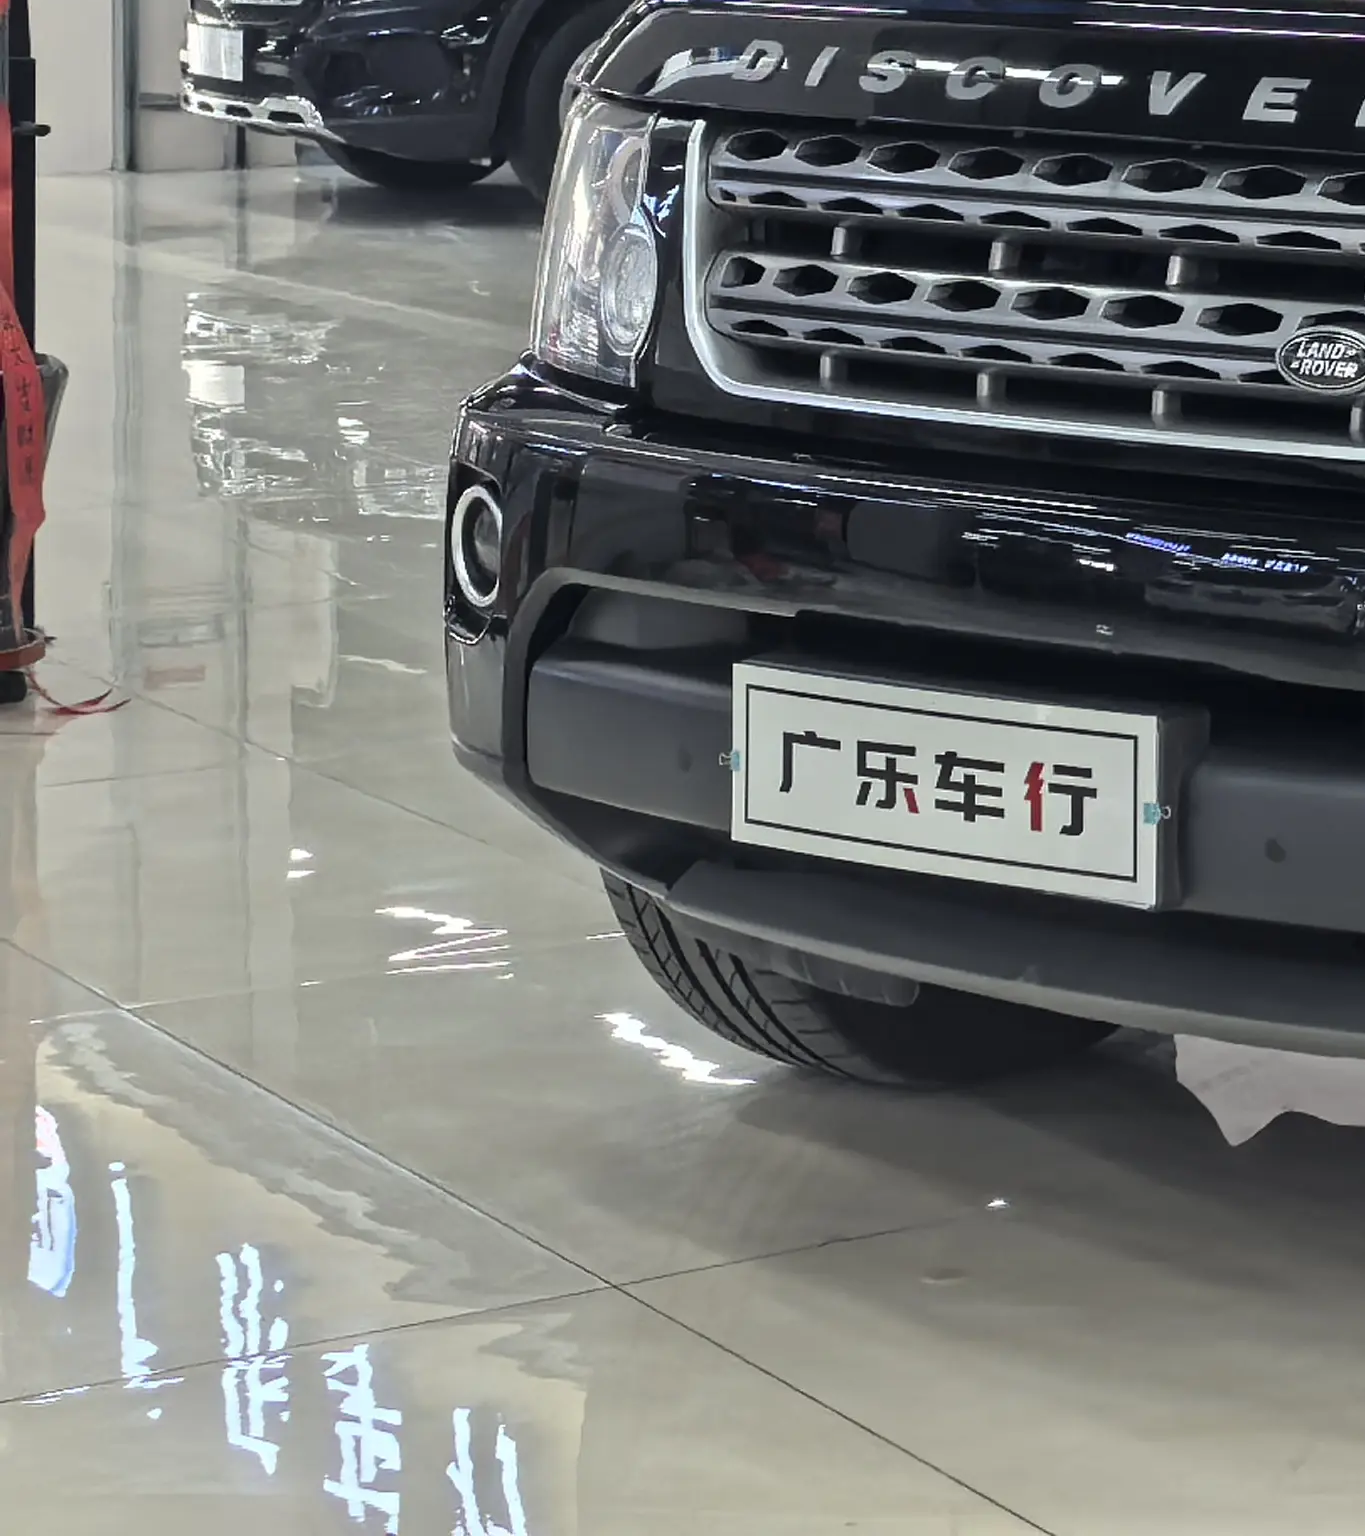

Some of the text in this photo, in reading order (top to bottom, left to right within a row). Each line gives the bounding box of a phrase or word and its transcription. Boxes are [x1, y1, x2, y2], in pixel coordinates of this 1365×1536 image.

[1296, 339, 1345, 360] LAND
[1299, 358, 1359, 378] ROVER
[779, 730, 1098, 837] 广乐车行
